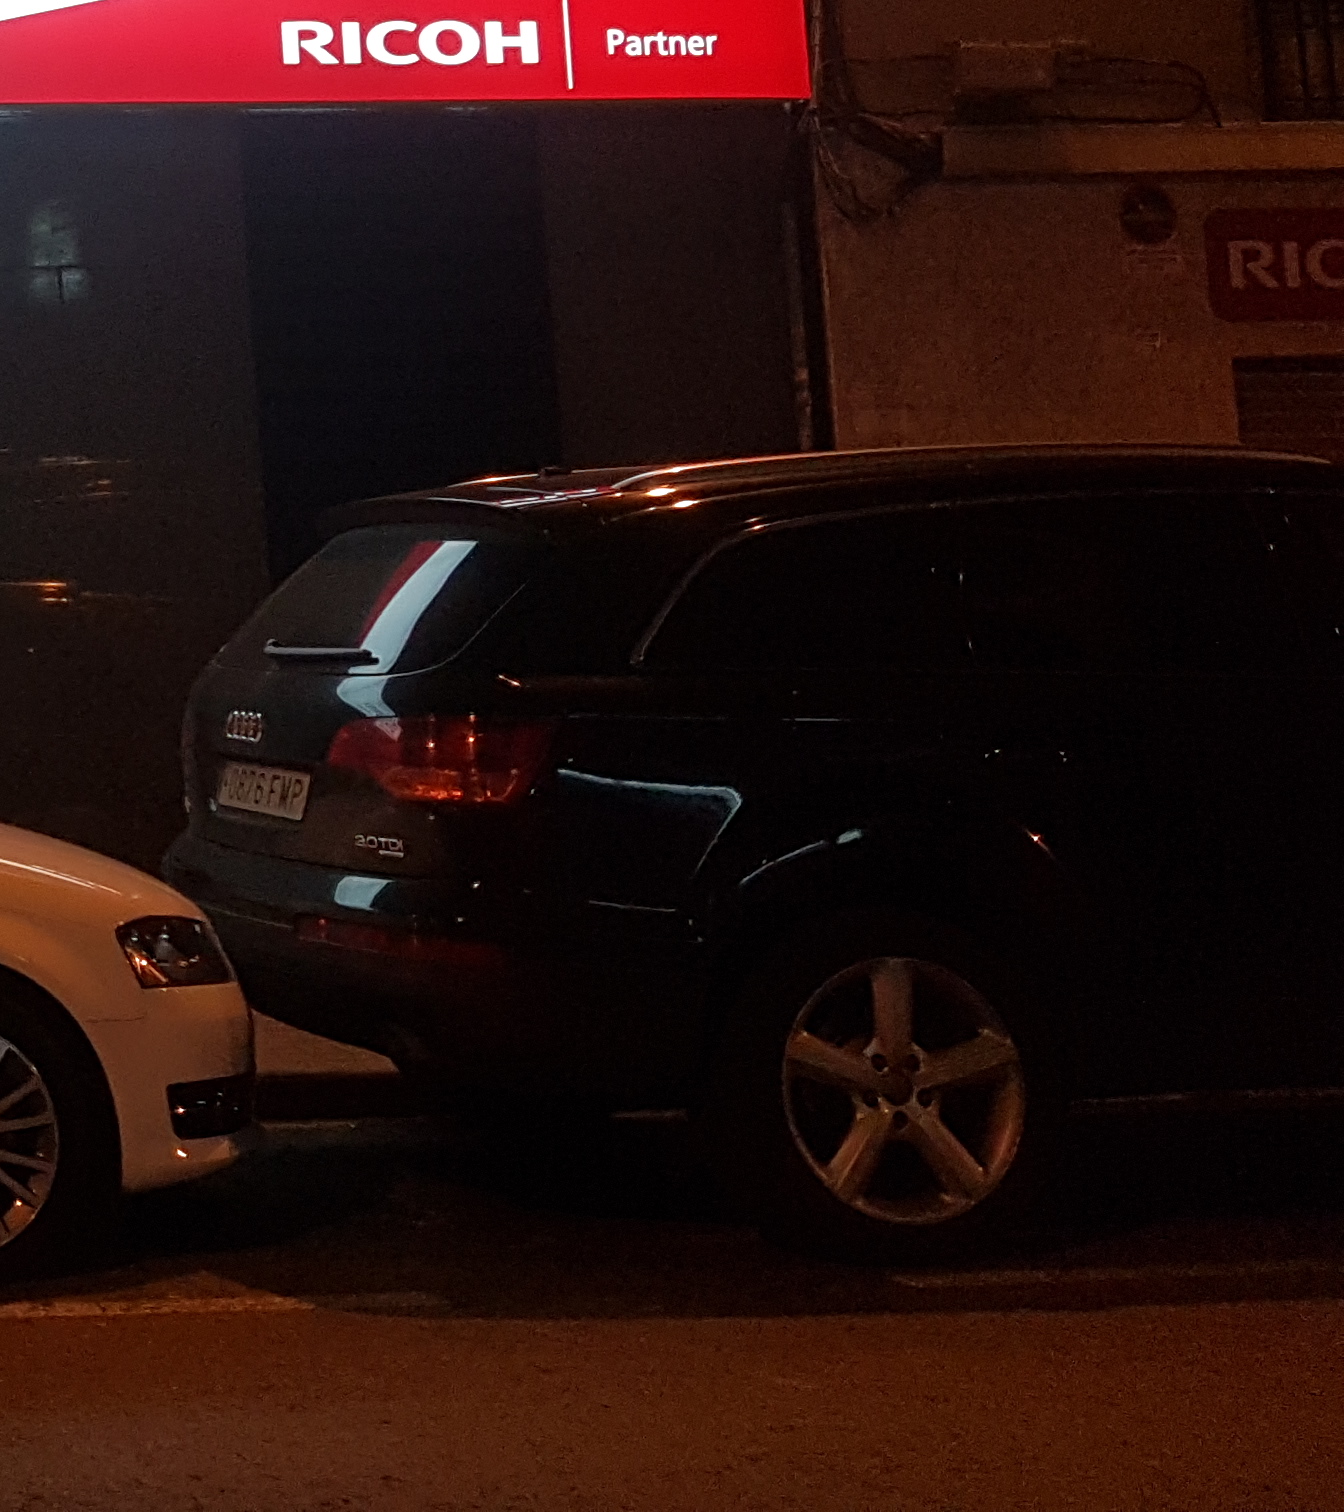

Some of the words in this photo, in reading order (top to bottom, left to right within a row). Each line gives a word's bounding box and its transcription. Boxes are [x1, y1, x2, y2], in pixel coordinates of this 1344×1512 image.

[281, 21, 541, 66] RICOH
[607, 29, 719, 58] Partner
[1227, 238, 1344, 288] RIC
